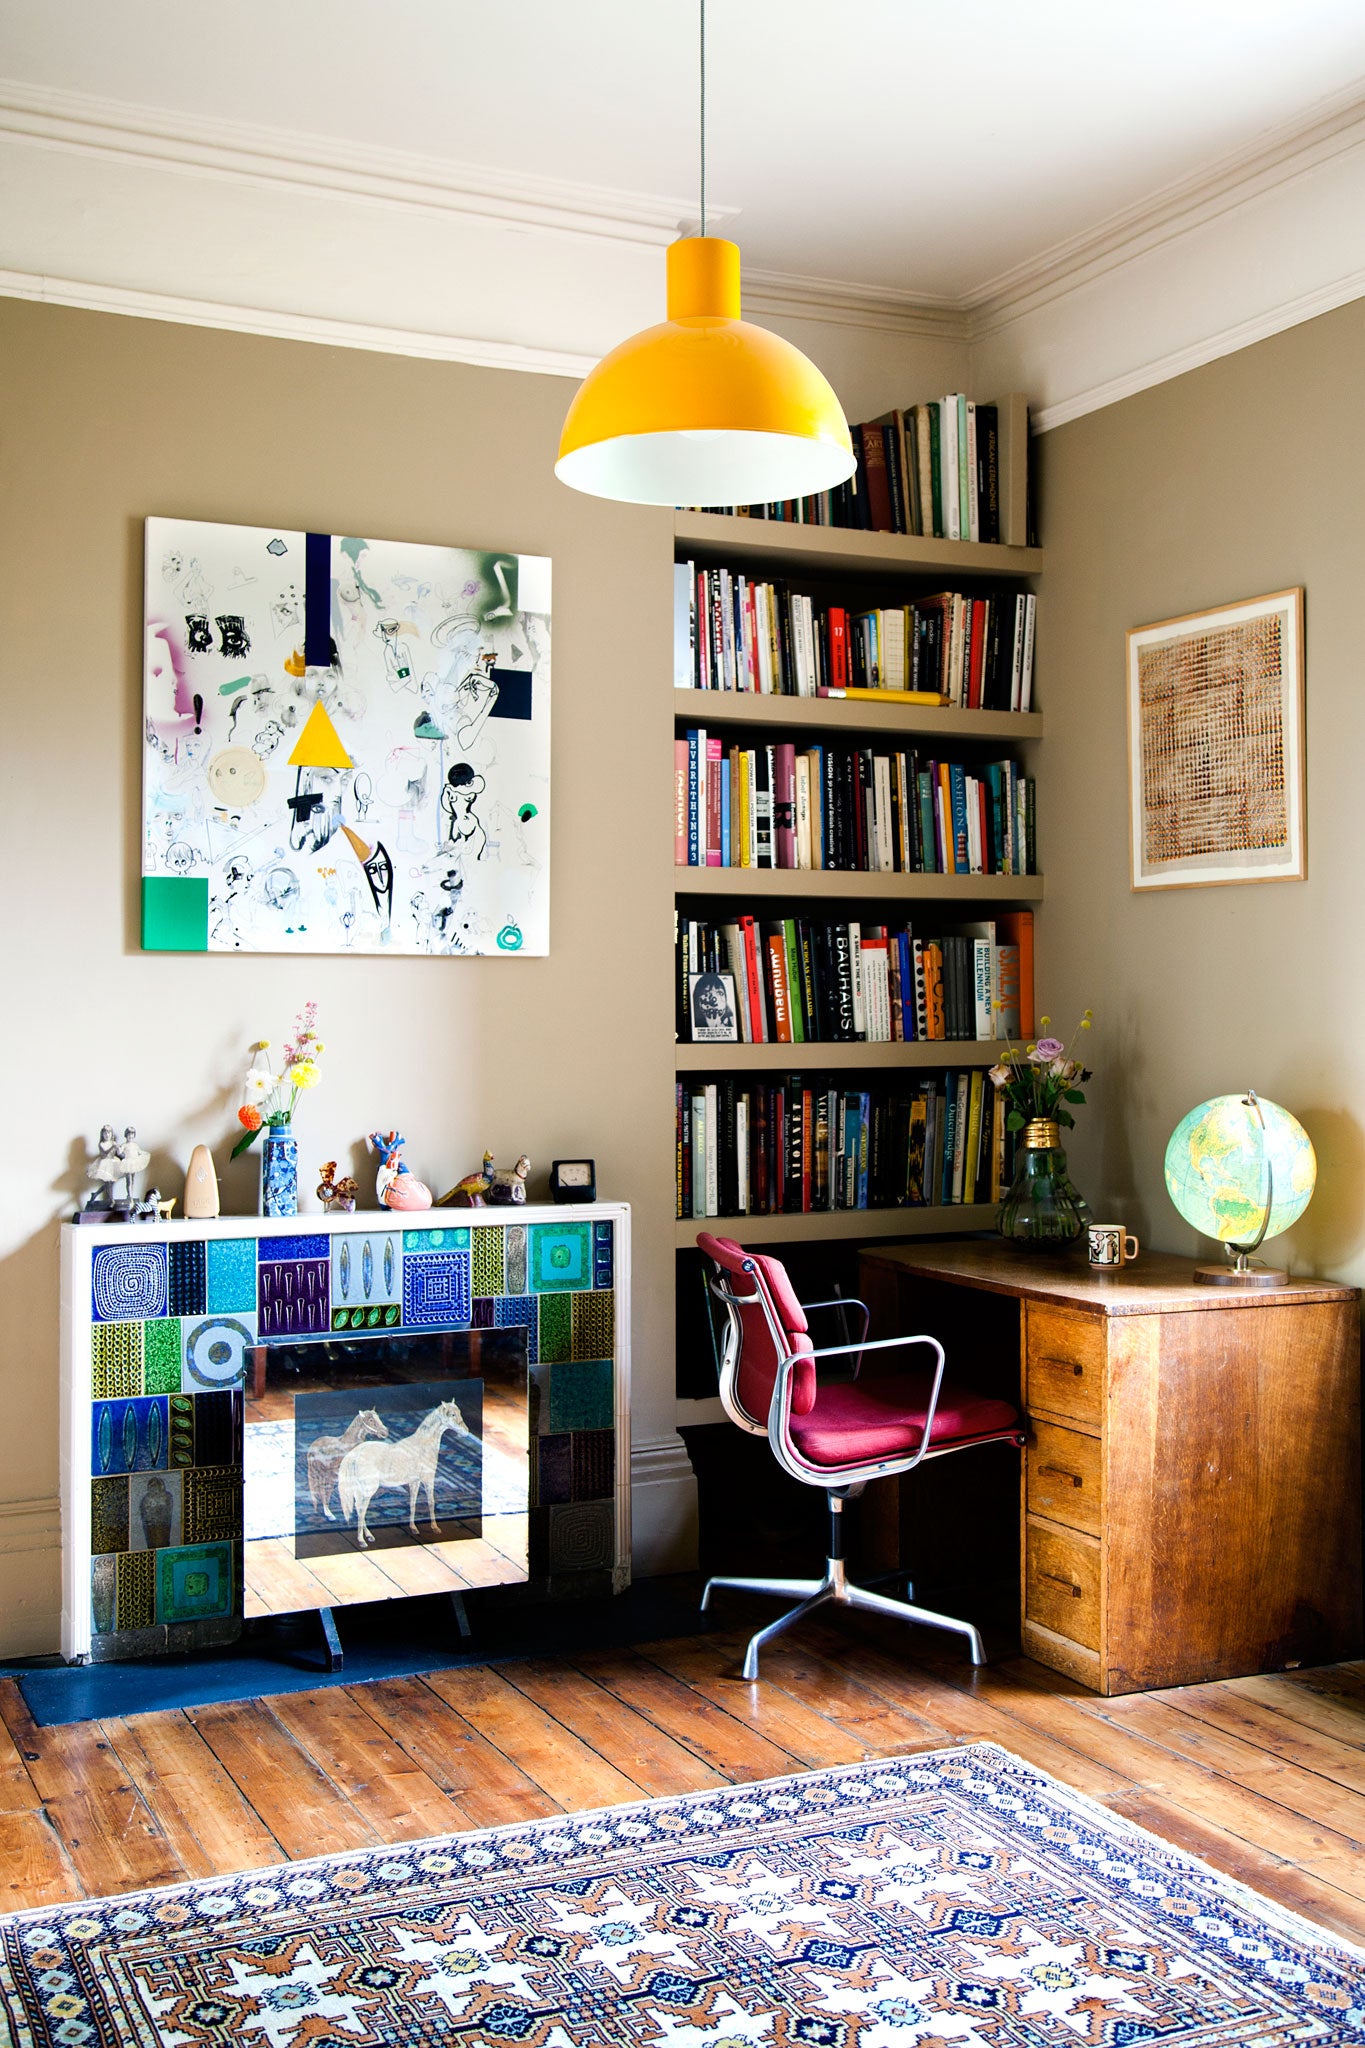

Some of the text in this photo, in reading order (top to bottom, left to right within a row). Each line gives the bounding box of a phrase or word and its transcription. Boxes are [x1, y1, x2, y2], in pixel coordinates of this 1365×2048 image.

[988, 430, 998, 512] AFRICAN CEREMONIES
[834, 626, 844, 637] 17
[928, 620, 936, 644] London
[966, 635, 971, 643] OF
[689, 740, 698, 862] EVERYTHING #3
[954, 767, 964, 827] FASHION
[802, 940, 813, 1017] NICHOLAS GEORGIADIS
[836, 937, 853, 1030] BAUHAUS
[976, 947, 984, 1001] MILLENNIUM
[983, 947, 991, 987] BUILDING
[817, 1095, 828, 1139] VOGUE
[957, 1102, 965, 1119] Great
[971, 1103, 980, 1137] Sander
[945, 1103, 956, 1162] Outerbridge
[955, 1120, 963, 1150] American
[707, 1145, 715, 1165] Images
[953, 1150, 962, 1173] Pin-Up
